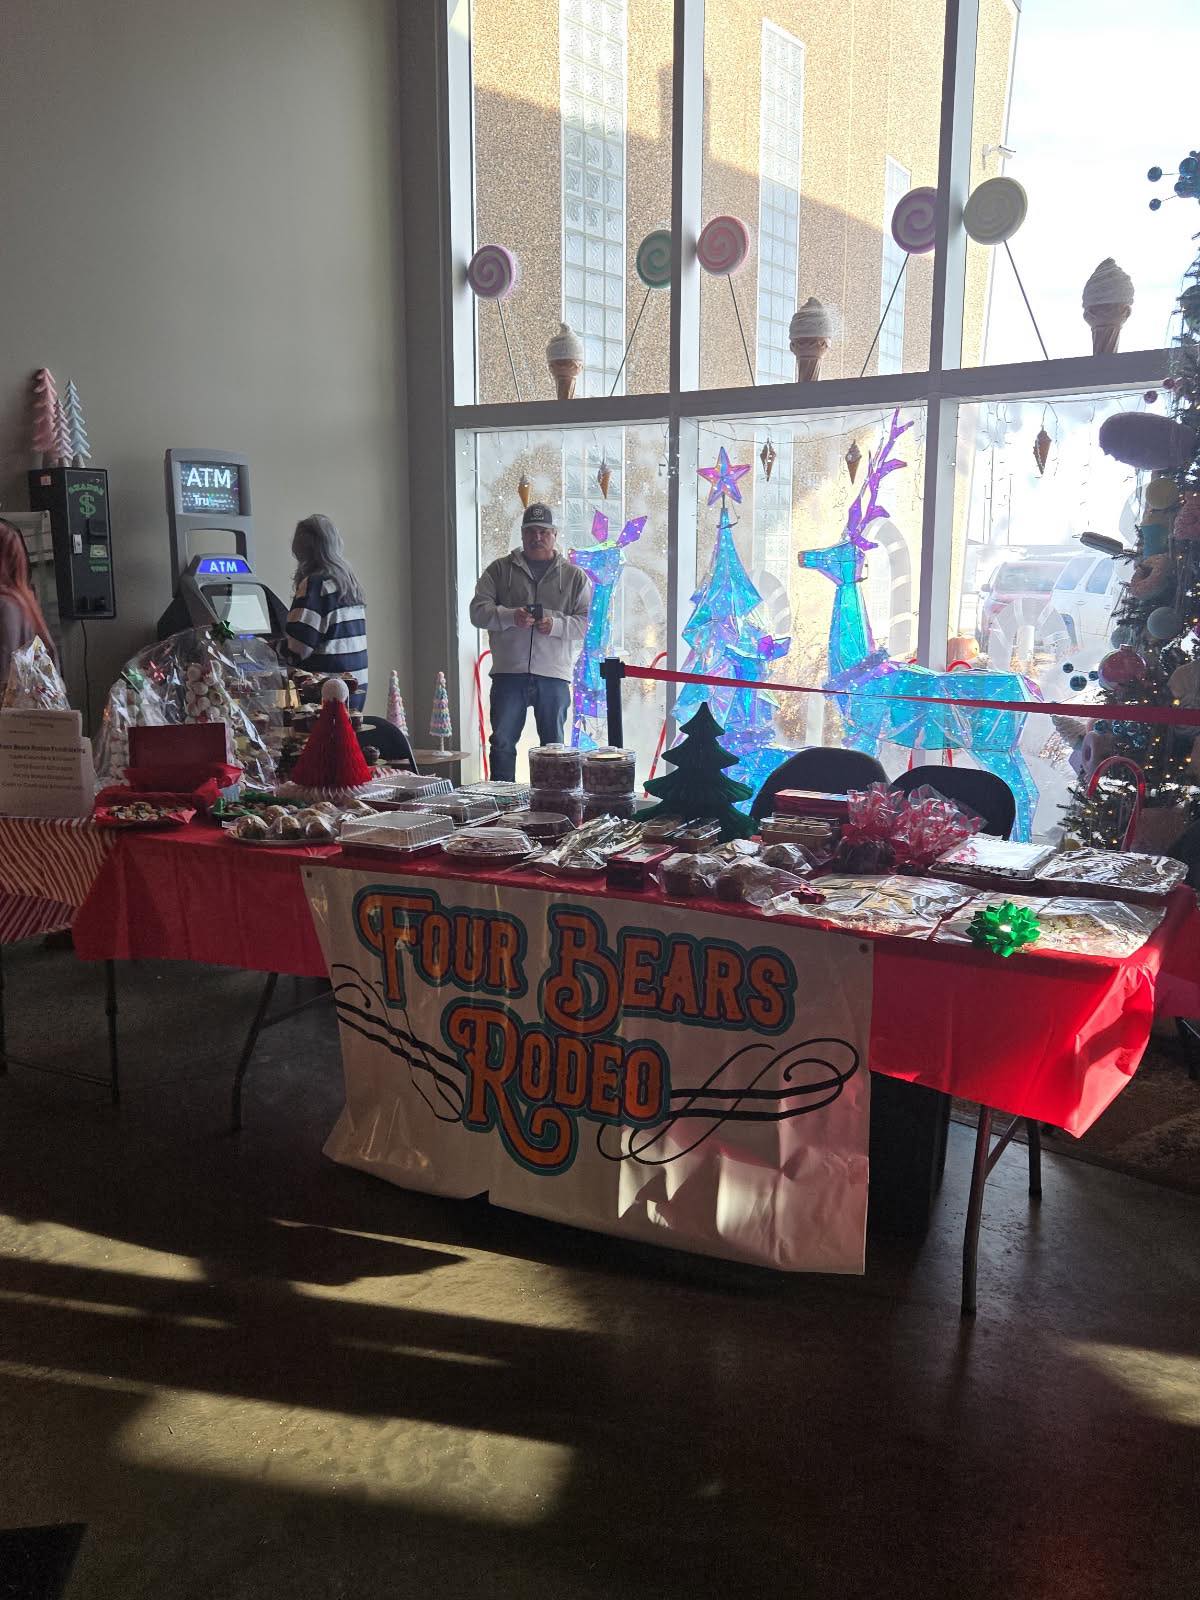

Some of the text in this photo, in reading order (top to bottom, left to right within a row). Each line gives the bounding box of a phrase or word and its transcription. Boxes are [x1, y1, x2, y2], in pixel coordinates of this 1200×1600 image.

[187, 467, 231, 489] ATM
[79, 492, 97, 518] $
[209, 561, 238, 573] ATM
[353, 884, 797, 1036] FOUR BEARS
[441, 997, 671, 1175] RODEO
